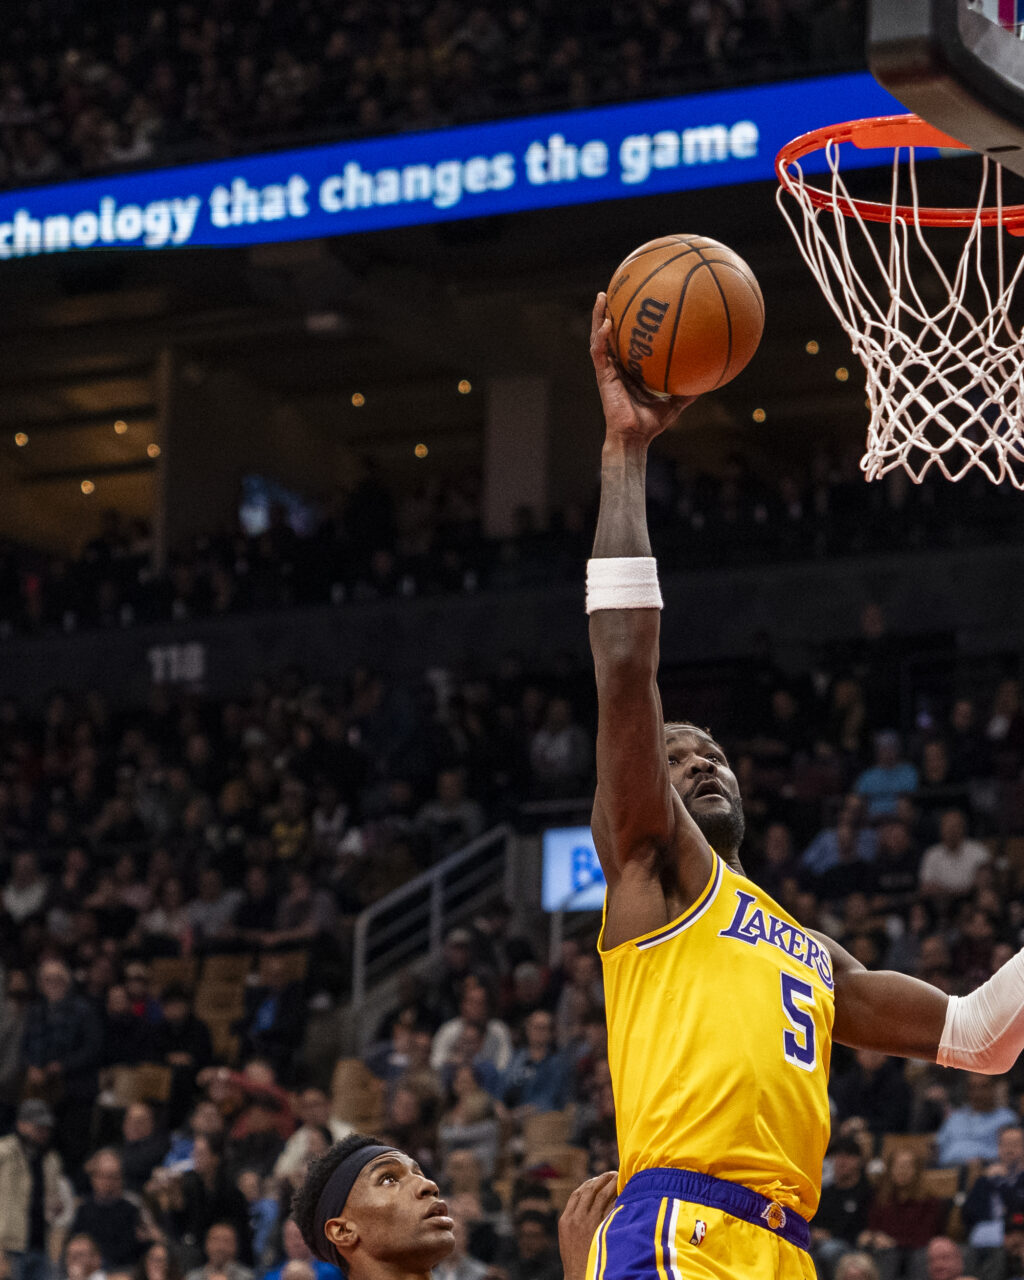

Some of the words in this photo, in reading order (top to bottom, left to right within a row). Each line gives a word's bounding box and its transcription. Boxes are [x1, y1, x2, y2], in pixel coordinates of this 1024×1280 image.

[209, 177, 309, 228] that
[319, 161, 515, 212] changes
[525, 133, 608, 185] the
[619, 120, 758, 184] game
[626, 297, 670, 380] Wilso
[718, 889, 834, 991] LAKERS
[780, 970, 817, 1072] 5
